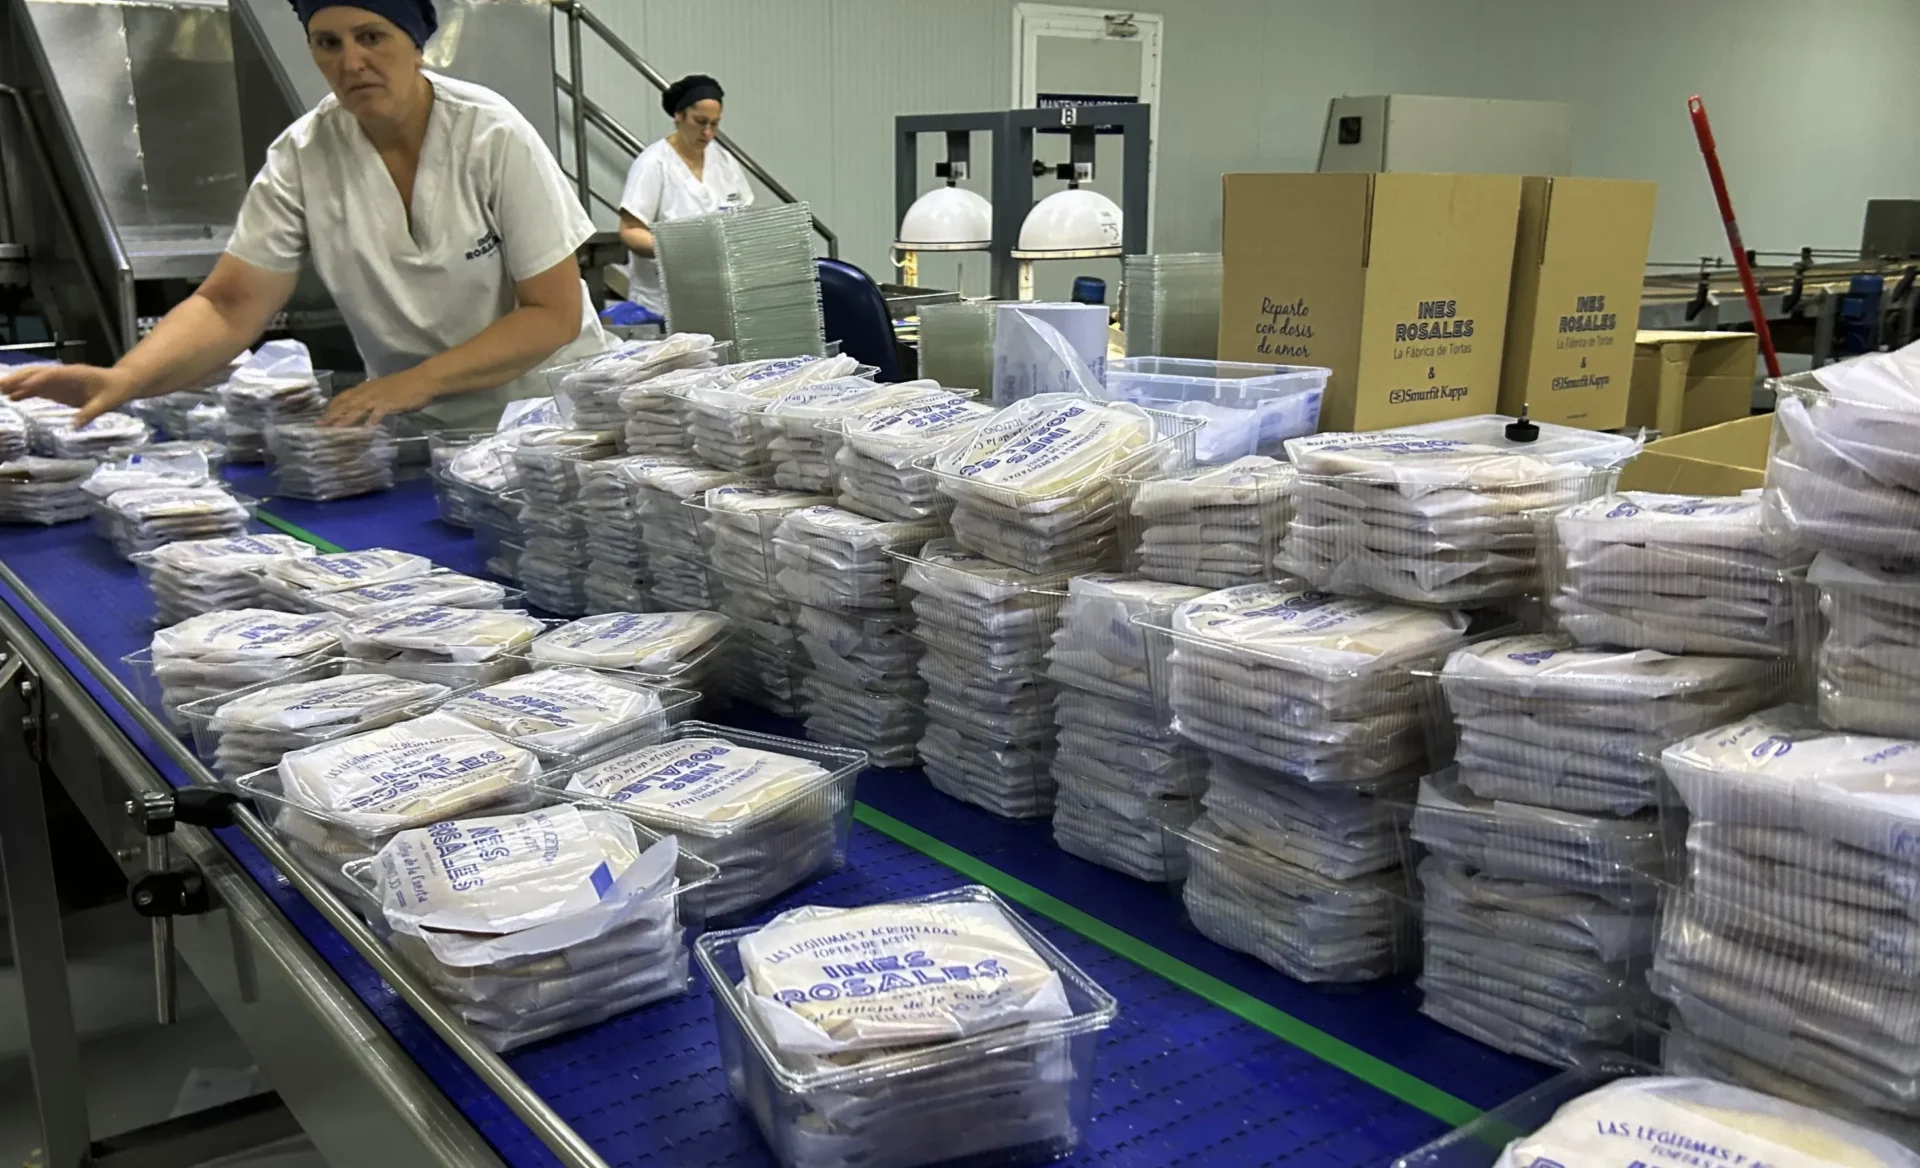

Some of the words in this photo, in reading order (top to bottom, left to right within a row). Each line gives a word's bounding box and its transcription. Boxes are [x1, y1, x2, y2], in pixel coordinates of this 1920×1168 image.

[1065, 108, 1073, 124] B
[1261, 297, 1309, 324] Reparto
[1418, 300, 1456, 319] INES
[1576, 295, 1605, 312] INES
[1256, 322, 1277, 335] con
[1279, 317, 1315, 338] dosis
[1395, 319, 1474, 342] ROSALES
[1559, 313, 1616, 333] ROSALES
[1256, 335, 1273, 354] de
[1274, 344, 1311, 358] amor
[1393, 348, 1404, 360] La
[1436, 344, 1447, 356] de
[1427, 366, 1435, 379] &
[1404, 386, 1439, 402] Smurfit
[1440, 385, 1468, 402] Kappa
[1006, 427, 1071, 464] INES
[610, 745, 731, 803] ROSALES
[659, 762, 725, 791] INES
[466, 826, 510, 861] NES
[765, 949, 791, 964] LAS
[857, 929, 866, 939] Y
[871, 925, 958, 937] ACREDITADAS
[813, 942, 860, 958] TORTAS
[861, 940, 878, 950] DE
[822, 950, 936, 979] INES
[773, 959, 1009, 1009] ROSALES
[1597, 1120, 1630, 1137] LAS
